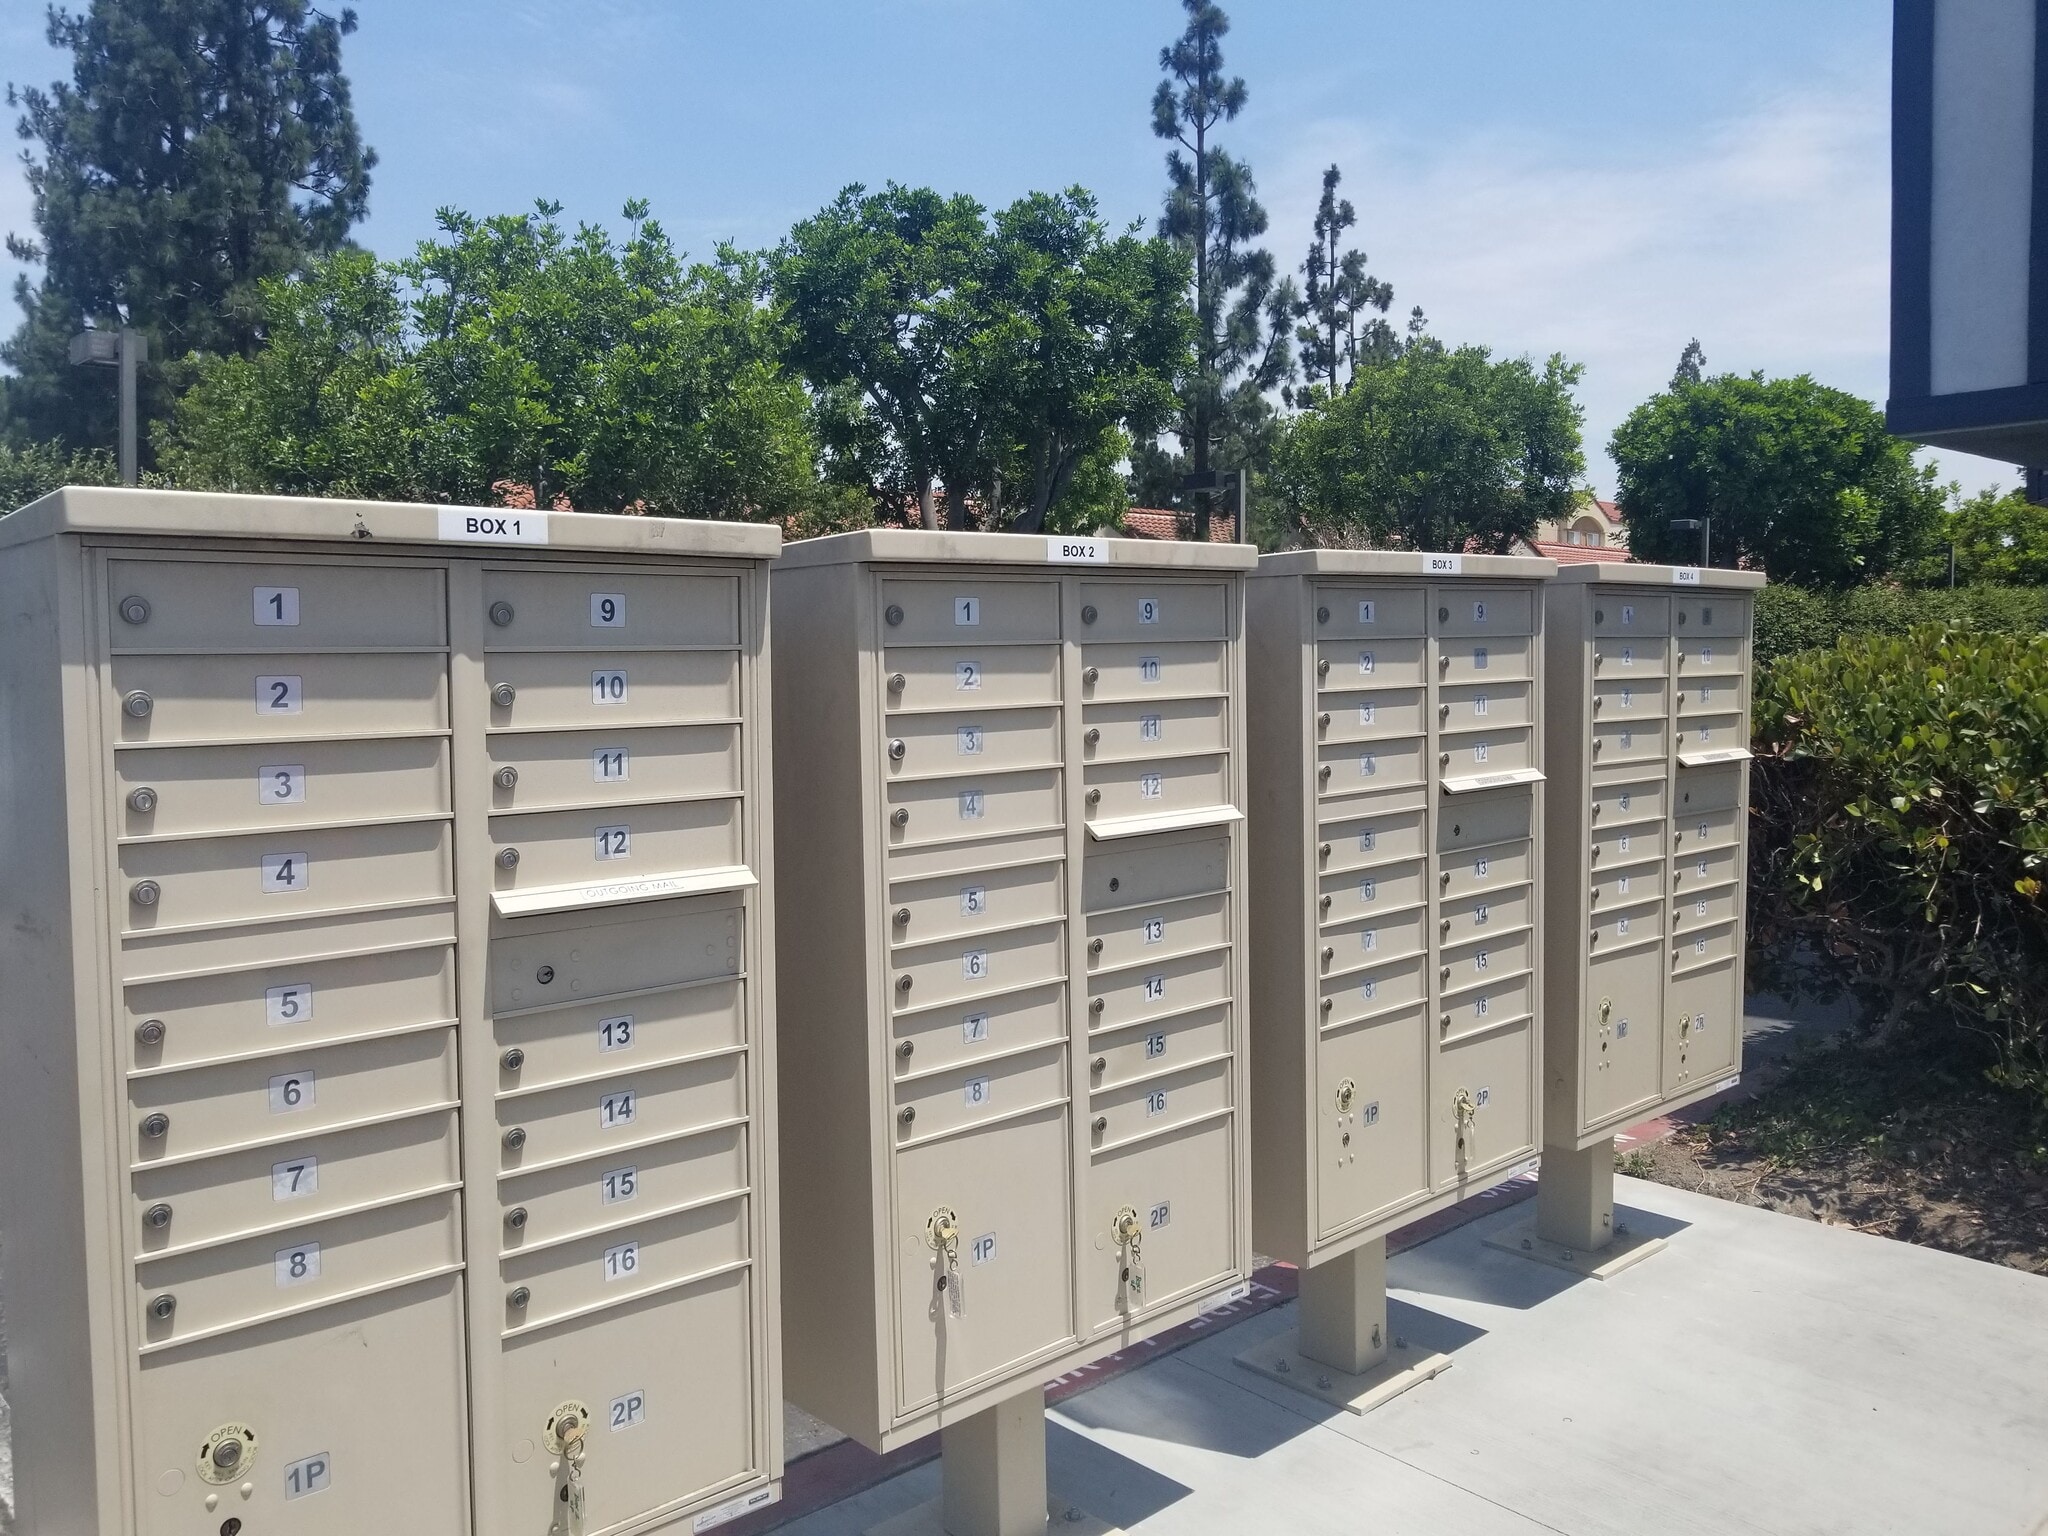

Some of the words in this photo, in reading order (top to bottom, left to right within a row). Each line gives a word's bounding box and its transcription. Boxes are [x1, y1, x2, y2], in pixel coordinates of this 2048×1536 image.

[466, 516, 506, 536] BOX
[514, 519, 522, 536] 1
[1062, 545, 1085, 558] BOX
[1088, 546, 1095, 558] 2
[1432, 560, 1447, 570] BOX
[1448, 561, 1452, 570] 3
[1679, 572, 1689, 580] BOX
[1689, 572, 1694, 580] 4
[270, 593, 283, 620] 1
[600, 598, 615, 623] 9
[963, 602, 971, 621] 1
[1144, 602, 1153, 620] 9
[1364, 604, 1369, 620] 1
[1477, 605, 1484, 619] 9
[1625, 608, 1630, 622] 1
[1364, 656, 1370, 670] 2
[1625, 650, 1630, 663] 2
[1702, 650, 1710, 661] 10
[964, 667, 974, 685] 2
[1141, 662, 1158, 679] 10
[270, 682, 289, 708] 2
[595, 676, 623, 699] 10
[1476, 698, 1486, 712] 11
[1364, 707, 1370, 722] 3
[1143, 719, 1158, 736] 11
[966, 731, 975, 750] 3
[1476, 745, 1486, 760] 12
[598, 753, 624, 777] 11
[274, 772, 292, 798] 3
[1143, 778, 1160, 795] 12
[966, 795, 976, 814] 4
[1622, 797, 1627, 809] 5
[1364, 832, 1371, 847] 5
[1698, 824, 1707, 838] 13
[598, 832, 626, 854] 12
[1621, 837, 1627, 850] 6
[275, 859, 295, 885] 4
[1475, 861, 1487, 876] 13
[1698, 863, 1707, 875] 14
[586, 884, 648, 897] OUTGOING
[652, 880, 678, 889] MAIL
[1364, 884, 1372, 898] 6
[1621, 878, 1626, 891] 7
[968, 892, 977, 910] 5
[1697, 901, 1706, 914] 15
[1475, 906, 1487, 922] 14
[1145, 921, 1162, 939] 13
[1620, 920, 1625, 932] 8
[1366, 933, 1372, 948] 7
[1696, 940, 1704, 952] 16
[970, 956, 980, 974] 6
[1476, 953, 1487, 968] 15
[1145, 979, 1163, 997] 14
[1365, 982, 1372, 998] 8
[280, 992, 299, 1017] 5
[1476, 1000, 1487, 1015] 16
[602, 1022, 630, 1046] 13
[970, 1019, 980, 1038] 7
[1147, 1036, 1164, 1055] 15
[283, 1079, 300, 1105] 6
[972, 1083, 982, 1101] 8
[1477, 1090, 1488, 1106] 2P
[604, 1096, 632, 1120] 14
[1148, 1093, 1165, 1112] 16
[1364, 1106, 1378, 1123] 1P
[286, 1166, 304, 1192] 7
[605, 1172, 634, 1197] 15
[933, 1207, 950, 1218] OPEN
[1151, 1206, 1168, 1227] 2P
[974, 1238, 993, 1261] 1P
[289, 1252, 307, 1278] 8
[606, 1248, 635, 1274] 16
[555, 1404, 580, 1417] OPEN
[613, 1396, 641, 1426] 2P
[210, 1426, 242, 1442] OPEN
[288, 1460, 325, 1493] 1P
